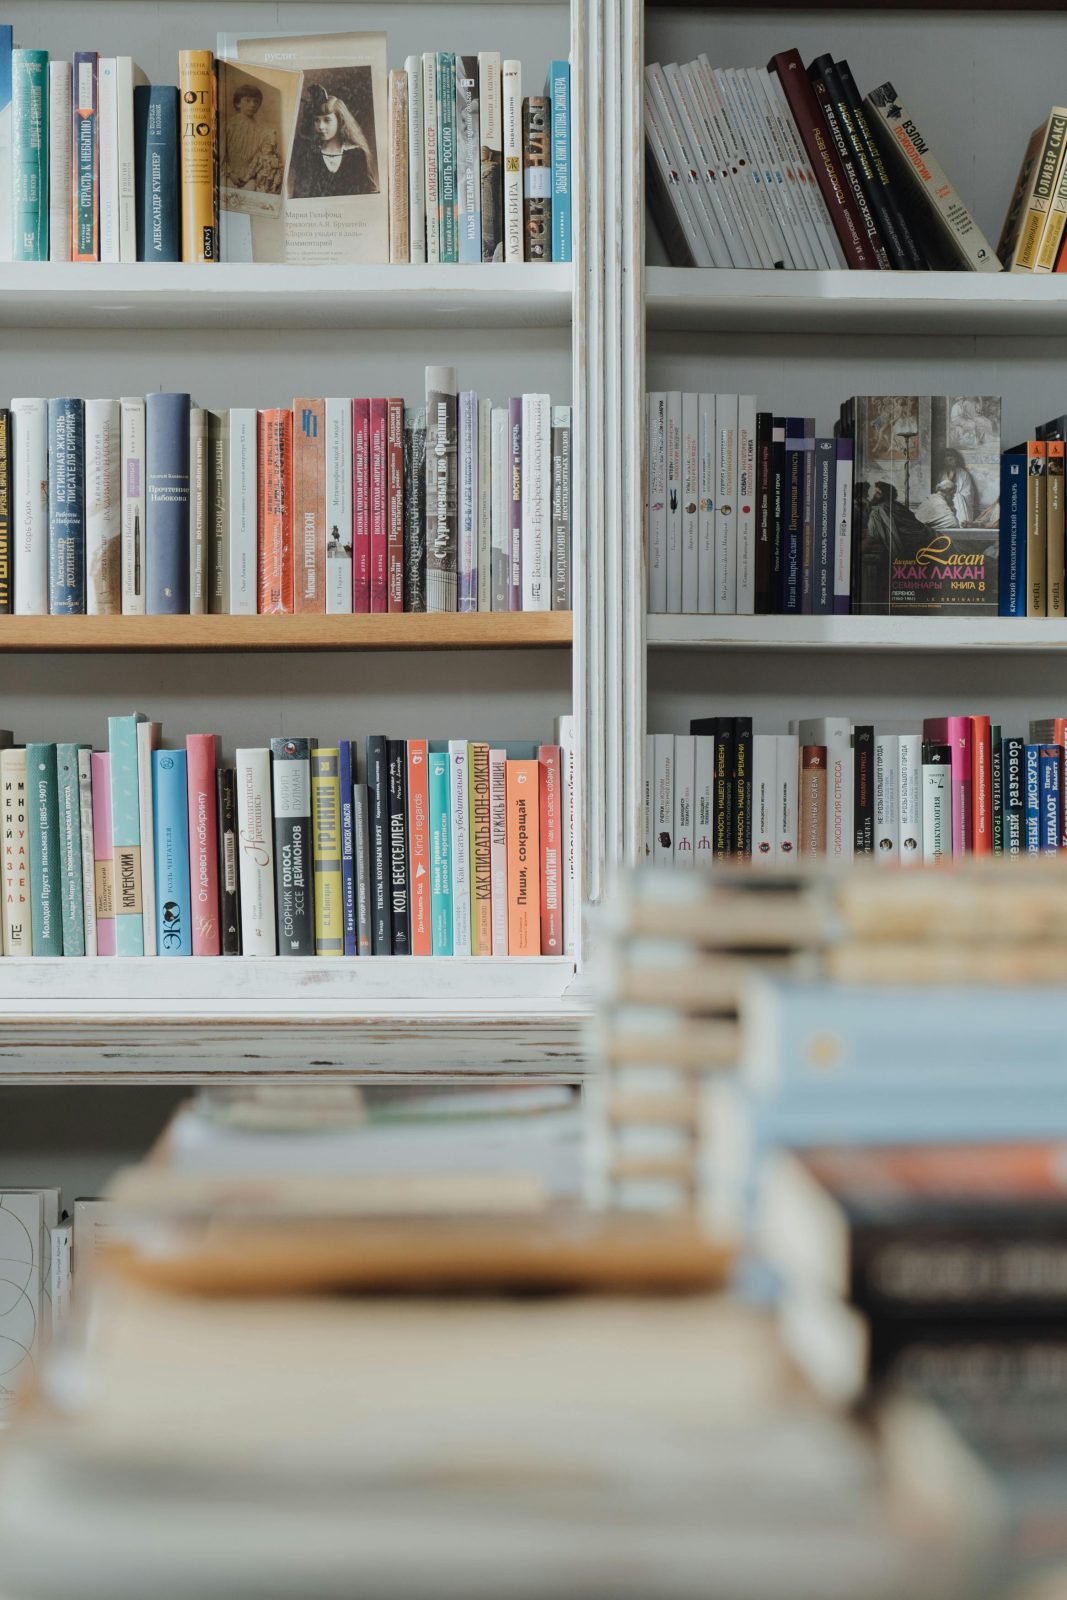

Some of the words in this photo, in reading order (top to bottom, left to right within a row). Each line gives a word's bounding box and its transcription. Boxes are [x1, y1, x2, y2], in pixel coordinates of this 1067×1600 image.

[554, 77, 566, 111] СИНКЛЕРА
[427, 127, 436, 146] СССР
[555, 113, 566, 138] ЭПТОНА
[824, 104, 848, 157] молитвы
[837, 102, 853, 135] ЖИЗНИ
[854, 108, 868, 141] ЖИЗНИ
[80, 120, 92, 162] НЕБЫТИЮ
[428, 146, 436, 154] В
[443, 127, 453, 163] РОССИЮ
[556, 140, 566, 161] КНИГИ
[813, 127, 826, 150] ВЕРЫ
[851, 134, 863, 154] ДЛЯ
[866, 141, 878, 161] ДЛЯ
[893, 124, 932, 183] ПСИХОЛОГИИ
[902, 119, 929, 156] ВЗЛОМ
[152, 153, 161, 193] КУШНЕР
[860, 156, 874, 180] МИФЫ
[1038, 149, 1057, 195] ОЛИВЕР
[1050, 118, 1066, 149] САКС
[80, 173, 92, 207] СТРАСТЬ
[428, 157, 437, 202] САМИЗДАТ
[443, 165, 453, 200] ПОНЯТЬ
[556, 162, 567, 194] ЗАБЫТЫЕ
[820, 151, 846, 205] ПСИХОЛОГИЯ
[509, 182, 518, 215] БИРД
[846, 163, 877, 238] Психология
[153, 194, 162, 251] АЛЕКСАНДР
[509, 218, 518, 256] МЭРИ
[56, 415, 65, 450] ЖИЗНЬ
[66, 413, 75, 451] СИРИНА
[434, 402, 449, 456] Франции
[512, 424, 520, 455] ГОРЕЧЬ
[57, 453, 66, 502] ИСТИННАЯ
[67, 453, 76, 502] ПИСАТЕЛЯ
[437, 459, 446, 473] во
[512, 465, 520, 501] ВОСТОРГ
[554, 456, 562, 484] людей
[435, 476, 450, 551] Тургеневым
[553, 486, 561, 521] Любовь
[24, 526, 33, 552] Игорь
[215, 510, 223, 537] ГЕРОИ
[304, 512, 316, 568] ГЕРШЕНЗОН
[56, 538, 66, 587] Александр
[66, 537, 75, 587] ДОЛИНИН
[435, 551, 446, 559] С
[557, 526, 566, 582] БОГДАНОВИЧ
[916, 535, 985, 565] Lacan
[512, 562, 520, 586] ВИКТОР
[892, 566, 928, 579] ЖАК
[930, 566, 985, 579] ЛАКАН
[892, 580, 943, 589] СЕМИНАРЫ
[951, 581, 976, 590] КНИГА
[978, 581, 985, 591] 8
[1009, 582, 1017, 612] КРАТКИЙ
[1033, 582, 1041, 610] ФРЕЙД
[291, 770, 302, 811] ПУЛМАН
[473, 745, 489, 823] НОН-ФИКШН
[493, 761, 505, 793] ПИШИ!
[546, 767, 555, 792] собаку
[834, 760, 842, 799] СТРЕССА
[1009, 741, 1022, 806] разговор
[1028, 751, 1039, 810] ДИСКУРС
[281, 776, 290, 811] ФИЛИП
[455, 769, 466, 831] убедительно
[197, 791, 208, 846] лабиринту
[241, 767, 269, 867] Неаполитанская
[254, 793, 263, 840] летопись
[316, 786, 336, 850] ГРАНИН
[343, 803, 351, 828] смысла
[415, 793, 425, 831] regards
[494, 803, 505, 845] ДЕРЖИСЬ
[517, 799, 528, 861] сокращай
[548, 818, 554, 828] не
[1047, 794, 1057, 846] ДИАЛОГ
[41, 831, 50, 864] письмах
[343, 830, 352, 855] поисках
[391, 813, 405, 885] БЕСТСЕЛЛЕРА
[415, 834, 423, 857] Kind
[433, 830, 441, 865] правила
[440, 812, 448, 857] переписки
[457, 832, 465, 864] писать
[474, 826, 490, 873] ПИСАТЬ
[198, 854, 209, 887] древа
[282, 844, 292, 888] ГОЛОСА
[292, 825, 304, 888] ДЕЙМОНОВ
[42, 874, 51, 898] Пруст
[119, 853, 135, 908] КАМЕНСКИЙ
[441, 859, 449, 895] деловой
[456, 866, 465, 884] Как
[475, 875, 491, 901] КАК
[517, 866, 528, 905] Пиши,
[545, 847, 558, 909] КОПИРАЙТИНГ
[199, 889, 208, 902] От
[284, 890, 294, 937] СБОРНИК
[295, 891, 304, 915] ЭССЕ
[394, 890, 407, 913] КОД
[41, 900, 50, 939] Молодой
[162, 901, 181, 949] ЭКО
